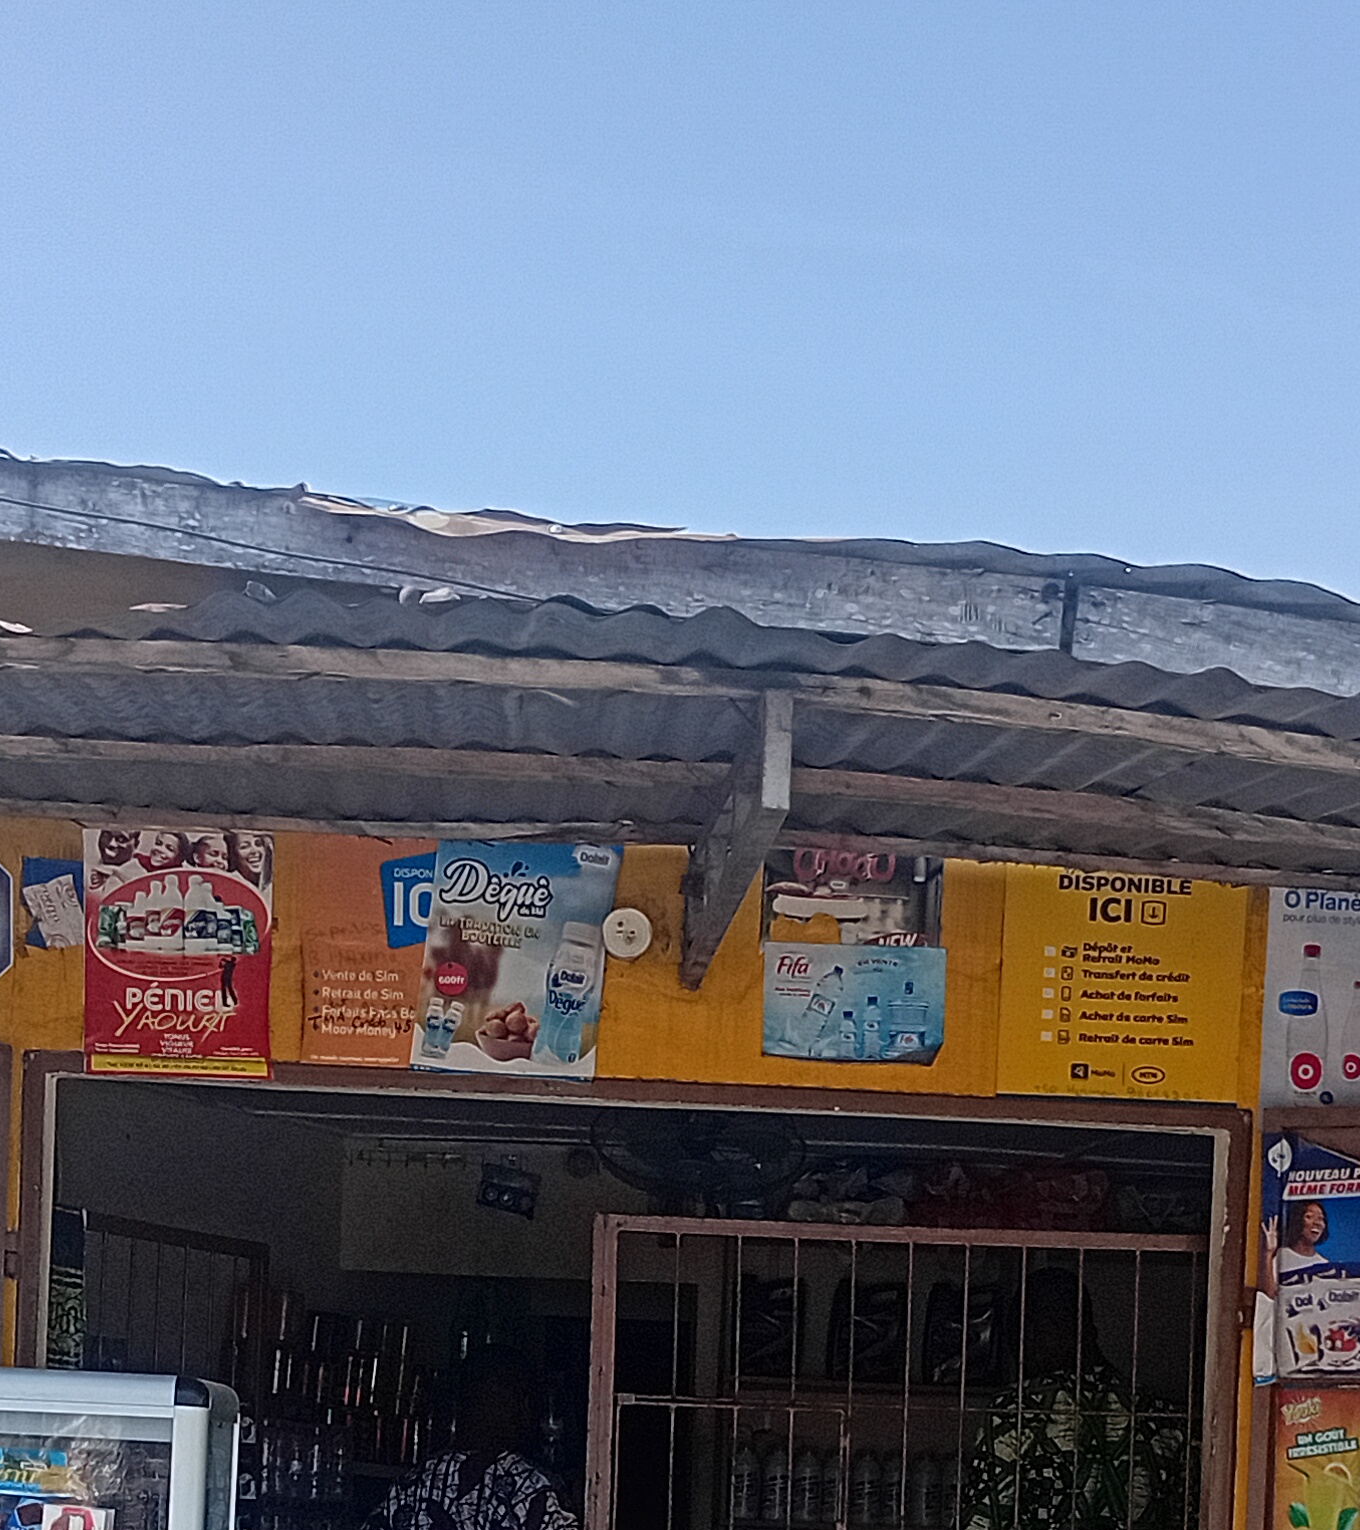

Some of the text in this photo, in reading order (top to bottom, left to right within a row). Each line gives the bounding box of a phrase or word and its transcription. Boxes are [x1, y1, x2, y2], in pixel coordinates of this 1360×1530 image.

[393, 867, 434, 878] DISPON
[1058, 874, 1192, 897] DISPONIBLE
[1088, 897, 1133, 923] ICI
[1283, 914, 1304, 923] pour
[1306, 914, 1327, 925] plus
[777, 954, 810, 978] Fifa
[375, 970, 399, 982] Sim
[1081, 968, 1137, 981] Transfert
[1139, 971, 1153, 982] de
[380, 989, 404, 1001] Sim
[1080, 989, 1116, 1000] Achat
[1079, 1011, 1114, 1022] Achat
[1133, 1013, 1164, 1023] carte
[1167, 1014, 1188, 1024] Sim
[1172, 1036, 1194, 1046] Sim
[1289, 1167, 1350, 1182] NOUVEAU
